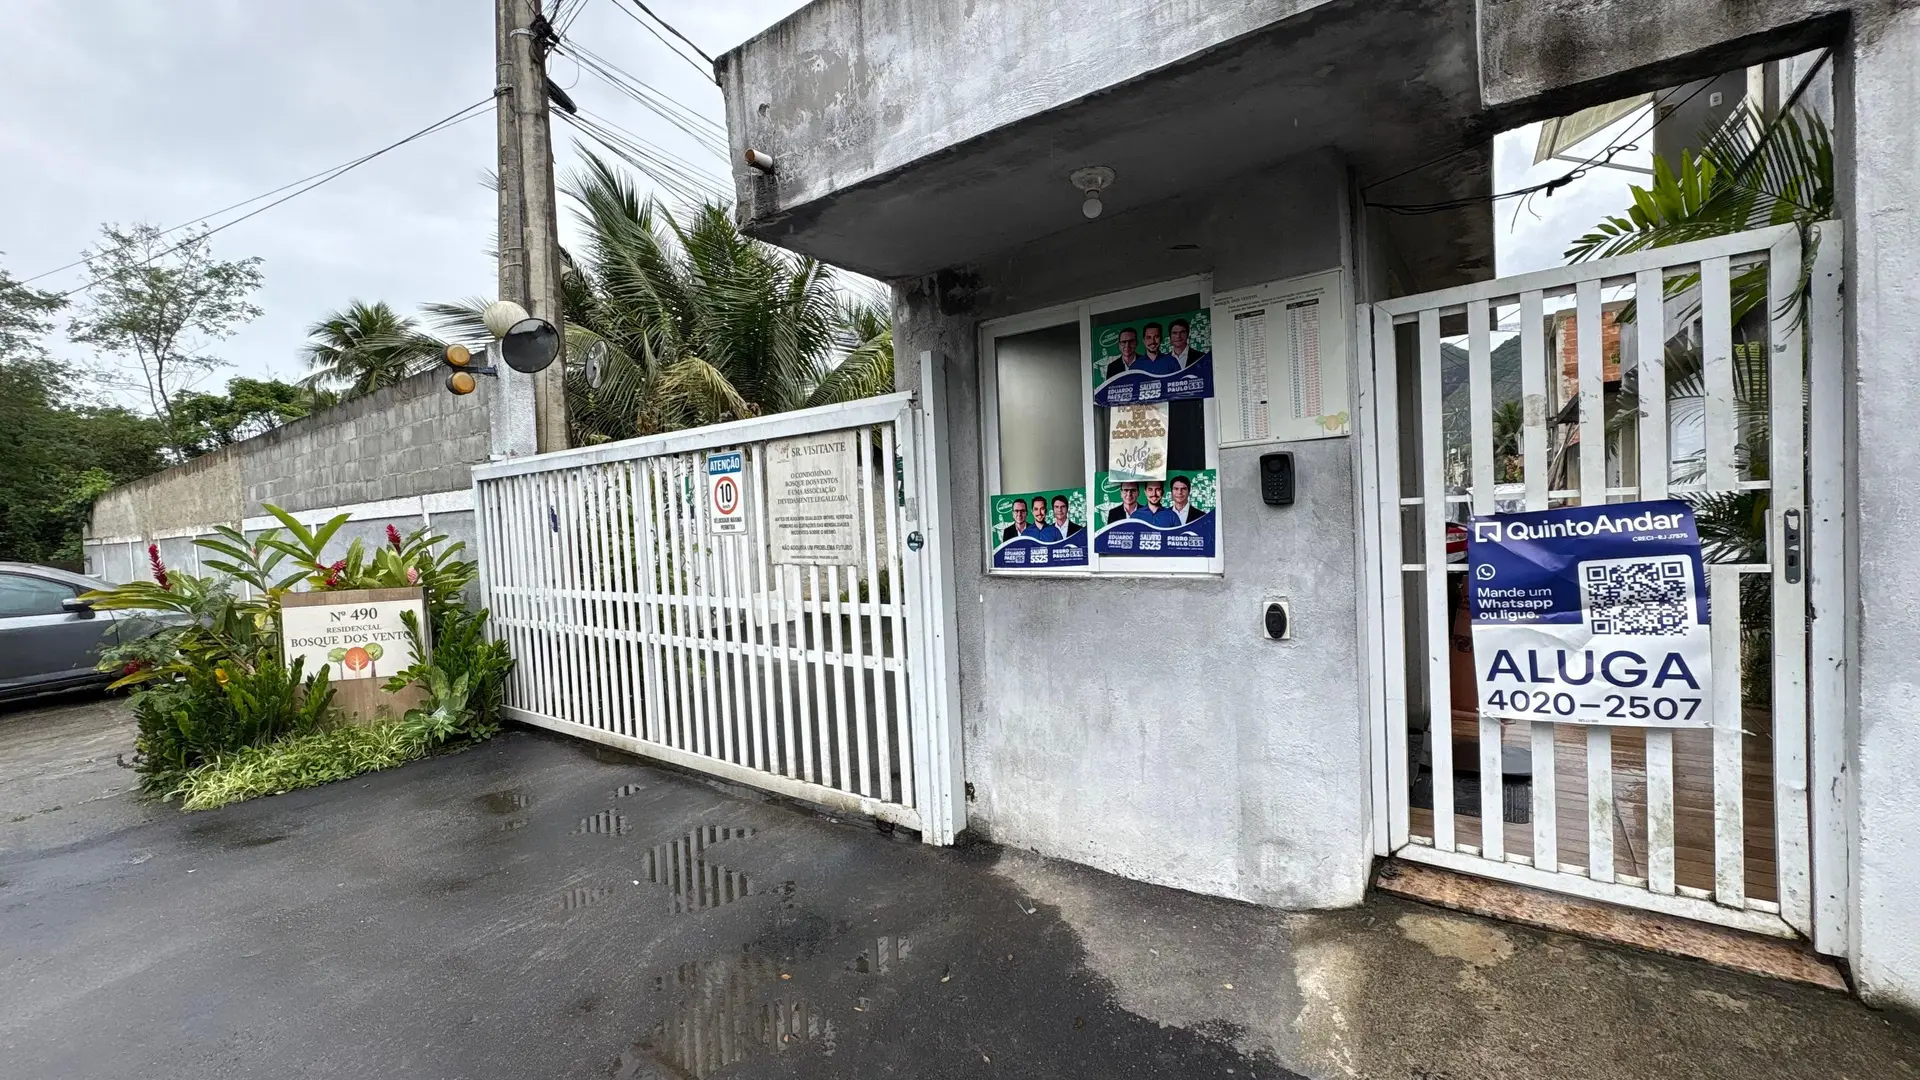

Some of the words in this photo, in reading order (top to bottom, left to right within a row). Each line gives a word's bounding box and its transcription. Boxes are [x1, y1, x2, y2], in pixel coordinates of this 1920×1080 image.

[1108, 387, 1133, 395] EDUARDO
[1139, 390, 1161, 400] 5525
[791, 447, 803, 457] SR.
[804, 442, 846, 456] VISITANTE
[710, 457, 740, 472] ATENÇÃO
[720, 483, 731, 503] 10
[1506, 511, 1684, 541] QuintoAndar
[1139, 541, 1161, 550] 5525
[1030, 555, 1048, 563] 5525
[1477, 587, 1525, 598] Mande
[1529, 588, 1552, 597] um
[1477, 599, 1554, 610] Whatsapp
[350, 607, 378, 621] 490
[1480, 611, 1498, 620] ou
[1500, 609, 1540, 622] ligue.
[326, 624, 382, 634] RESIDENCIAL
[291, 635, 339, 648] BOSQUE
[343, 633, 369, 644] DOS
[1486, 649, 1701, 690] ALUGA
[1487, 689, 1702, 721] 4020-2507
